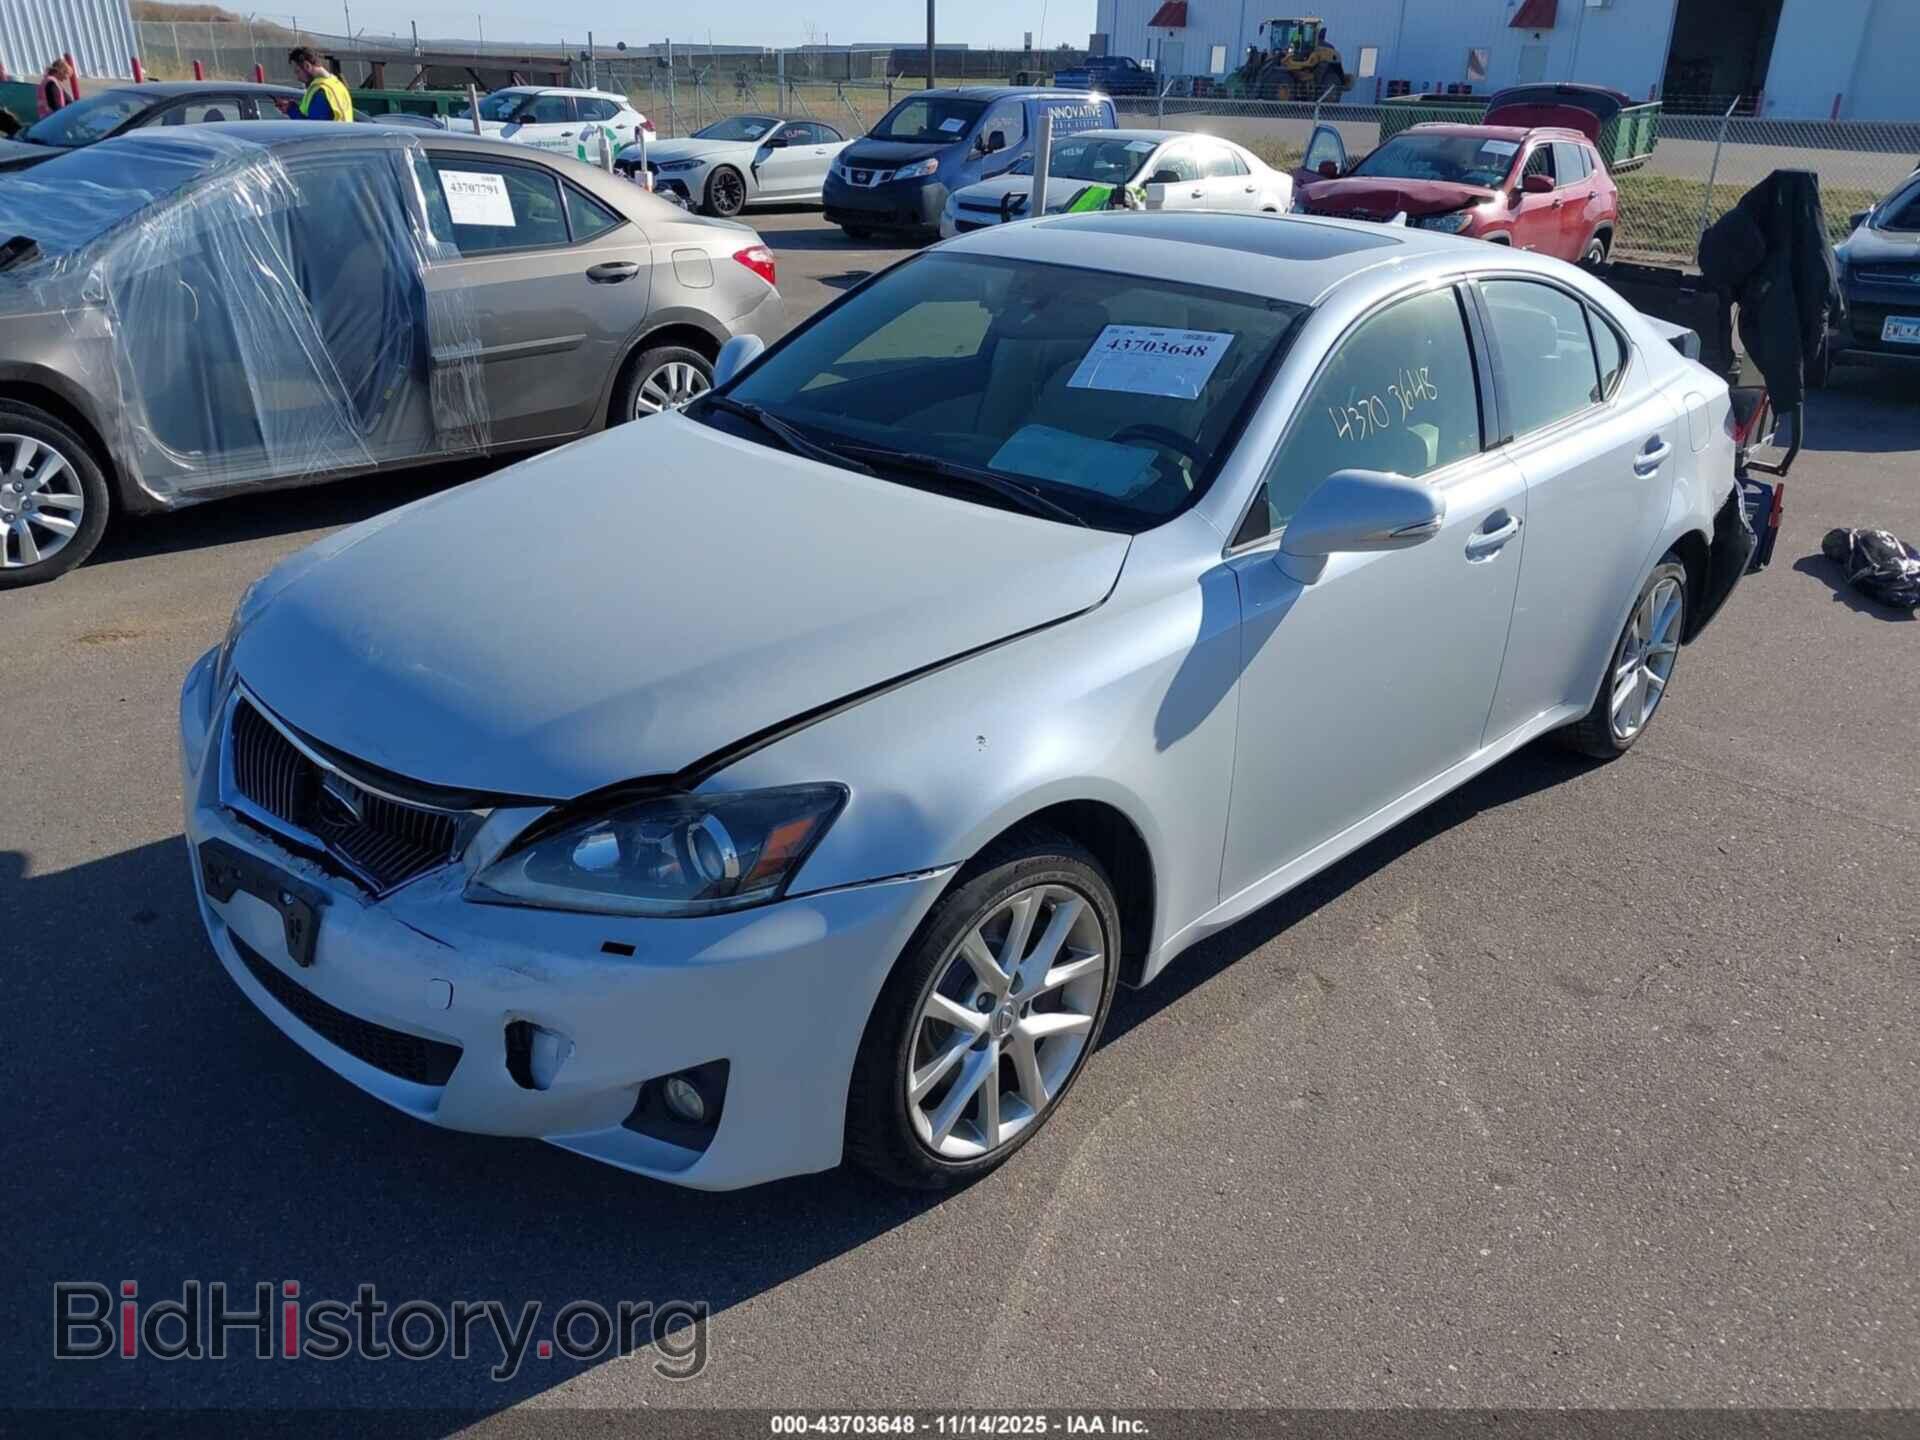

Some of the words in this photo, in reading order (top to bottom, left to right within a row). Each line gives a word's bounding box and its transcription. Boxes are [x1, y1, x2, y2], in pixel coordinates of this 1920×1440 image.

[1048, 105, 1103, 119] INNOVATIVE
[1106, 338, 1208, 357] 43703648
[1328, 395, 1390, 441] 4370
[1387, 366, 1438, 423] 3648
